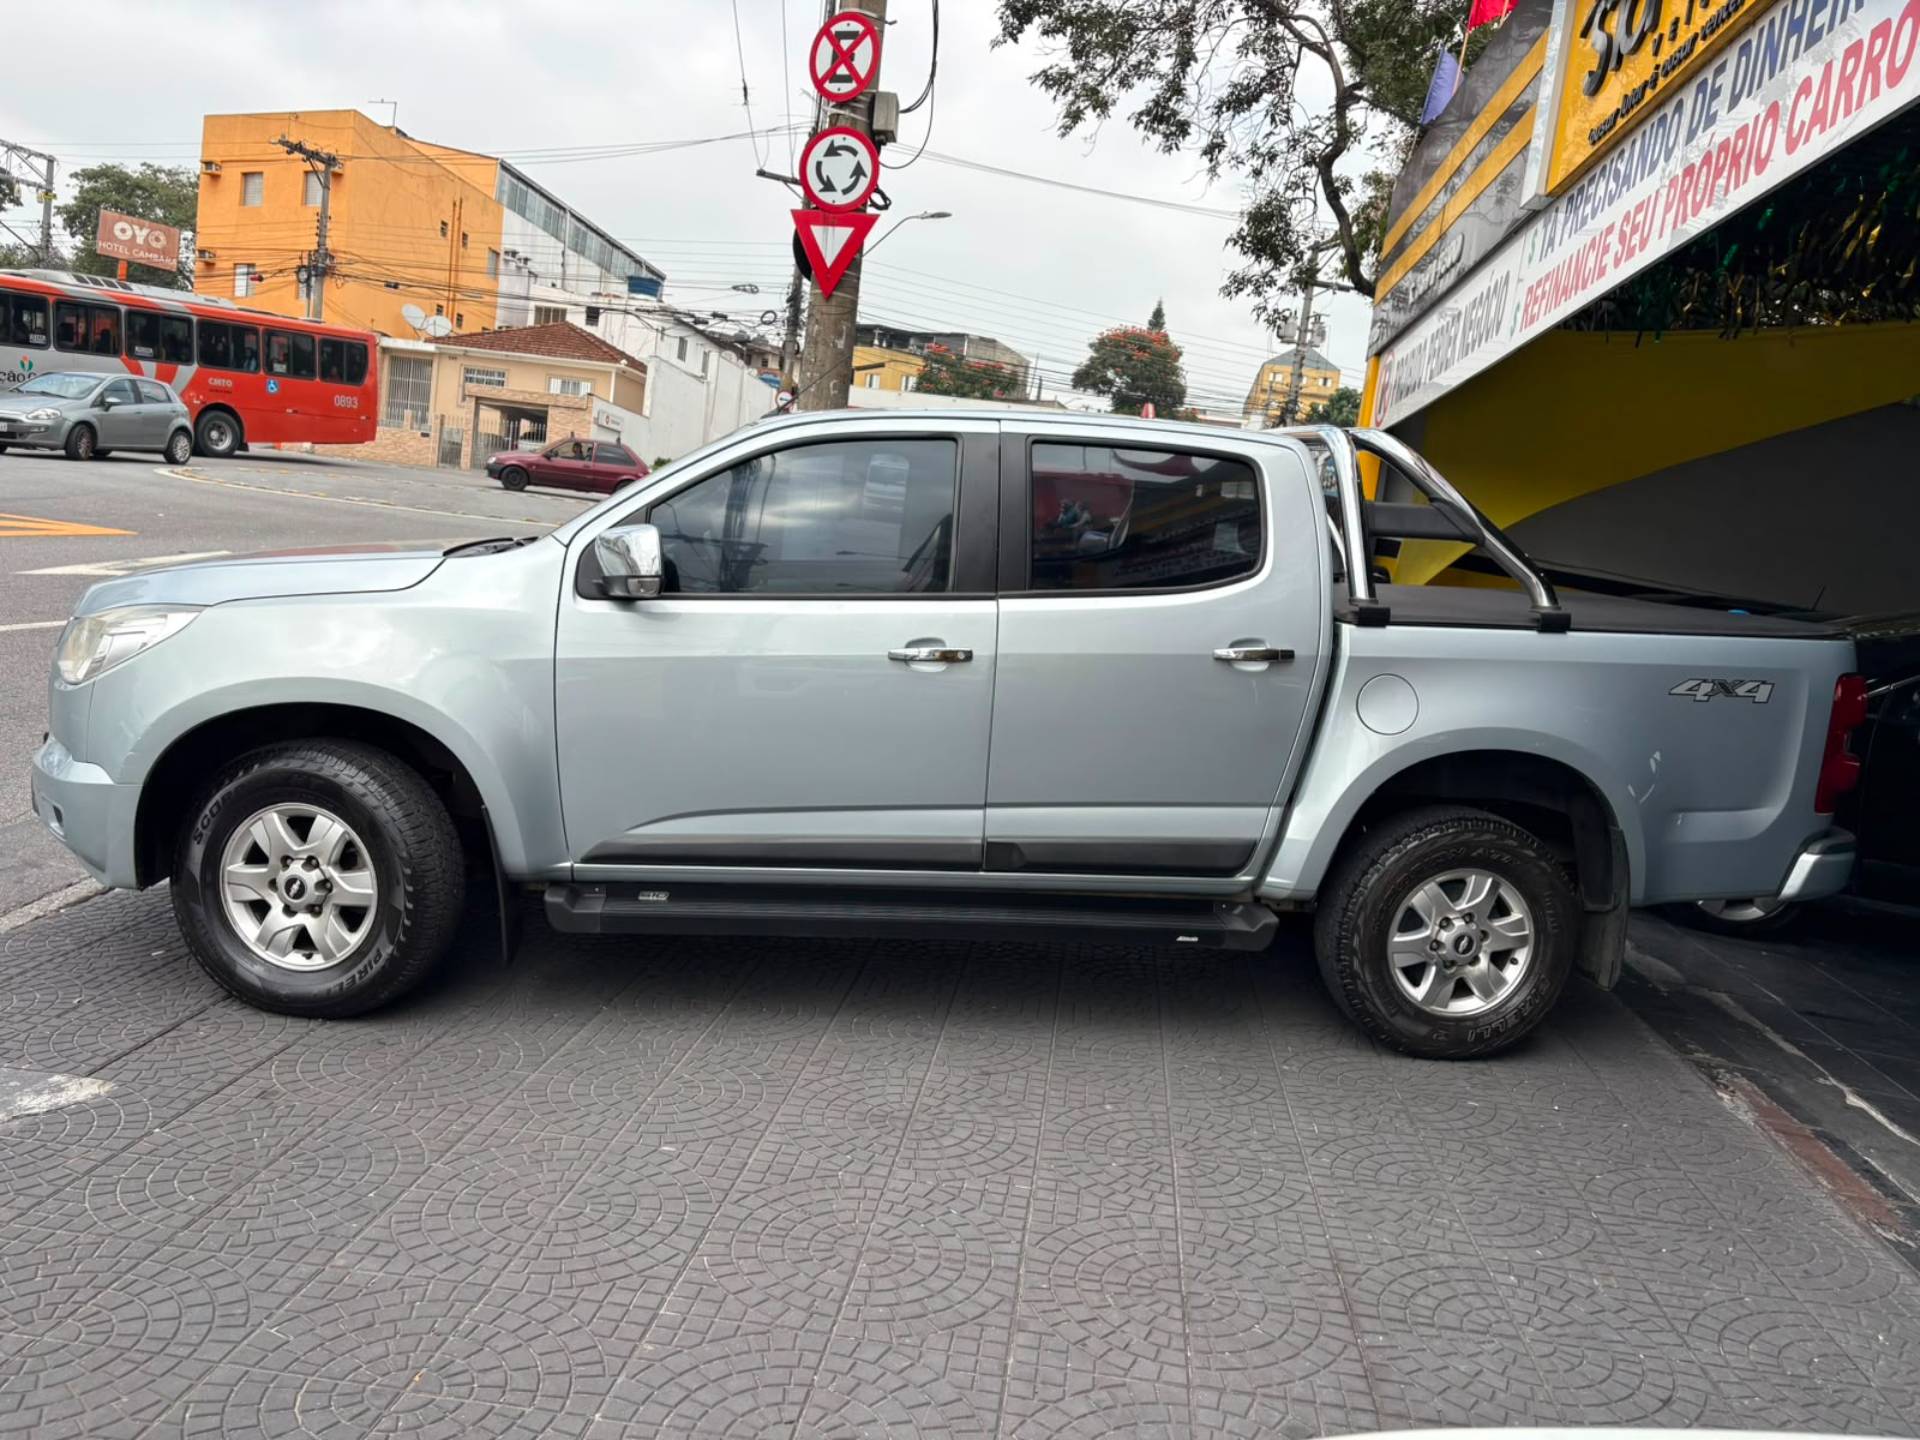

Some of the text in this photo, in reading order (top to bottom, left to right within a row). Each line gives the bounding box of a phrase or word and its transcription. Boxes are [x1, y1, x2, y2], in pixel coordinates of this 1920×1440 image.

[1519, 221, 1616, 333] REFINANCIE
[1613, 187, 1661, 269] SEU
[1658, 99, 1780, 240] PRÓPRIO
[1784, 0, 1920, 157] CARRO
[1559, 97, 1685, 247] PRECISANDO
[1685, 57, 1728, 147] DE
[99, 241, 130, 255] HOTEL
[113, 221, 167, 249] OYO
